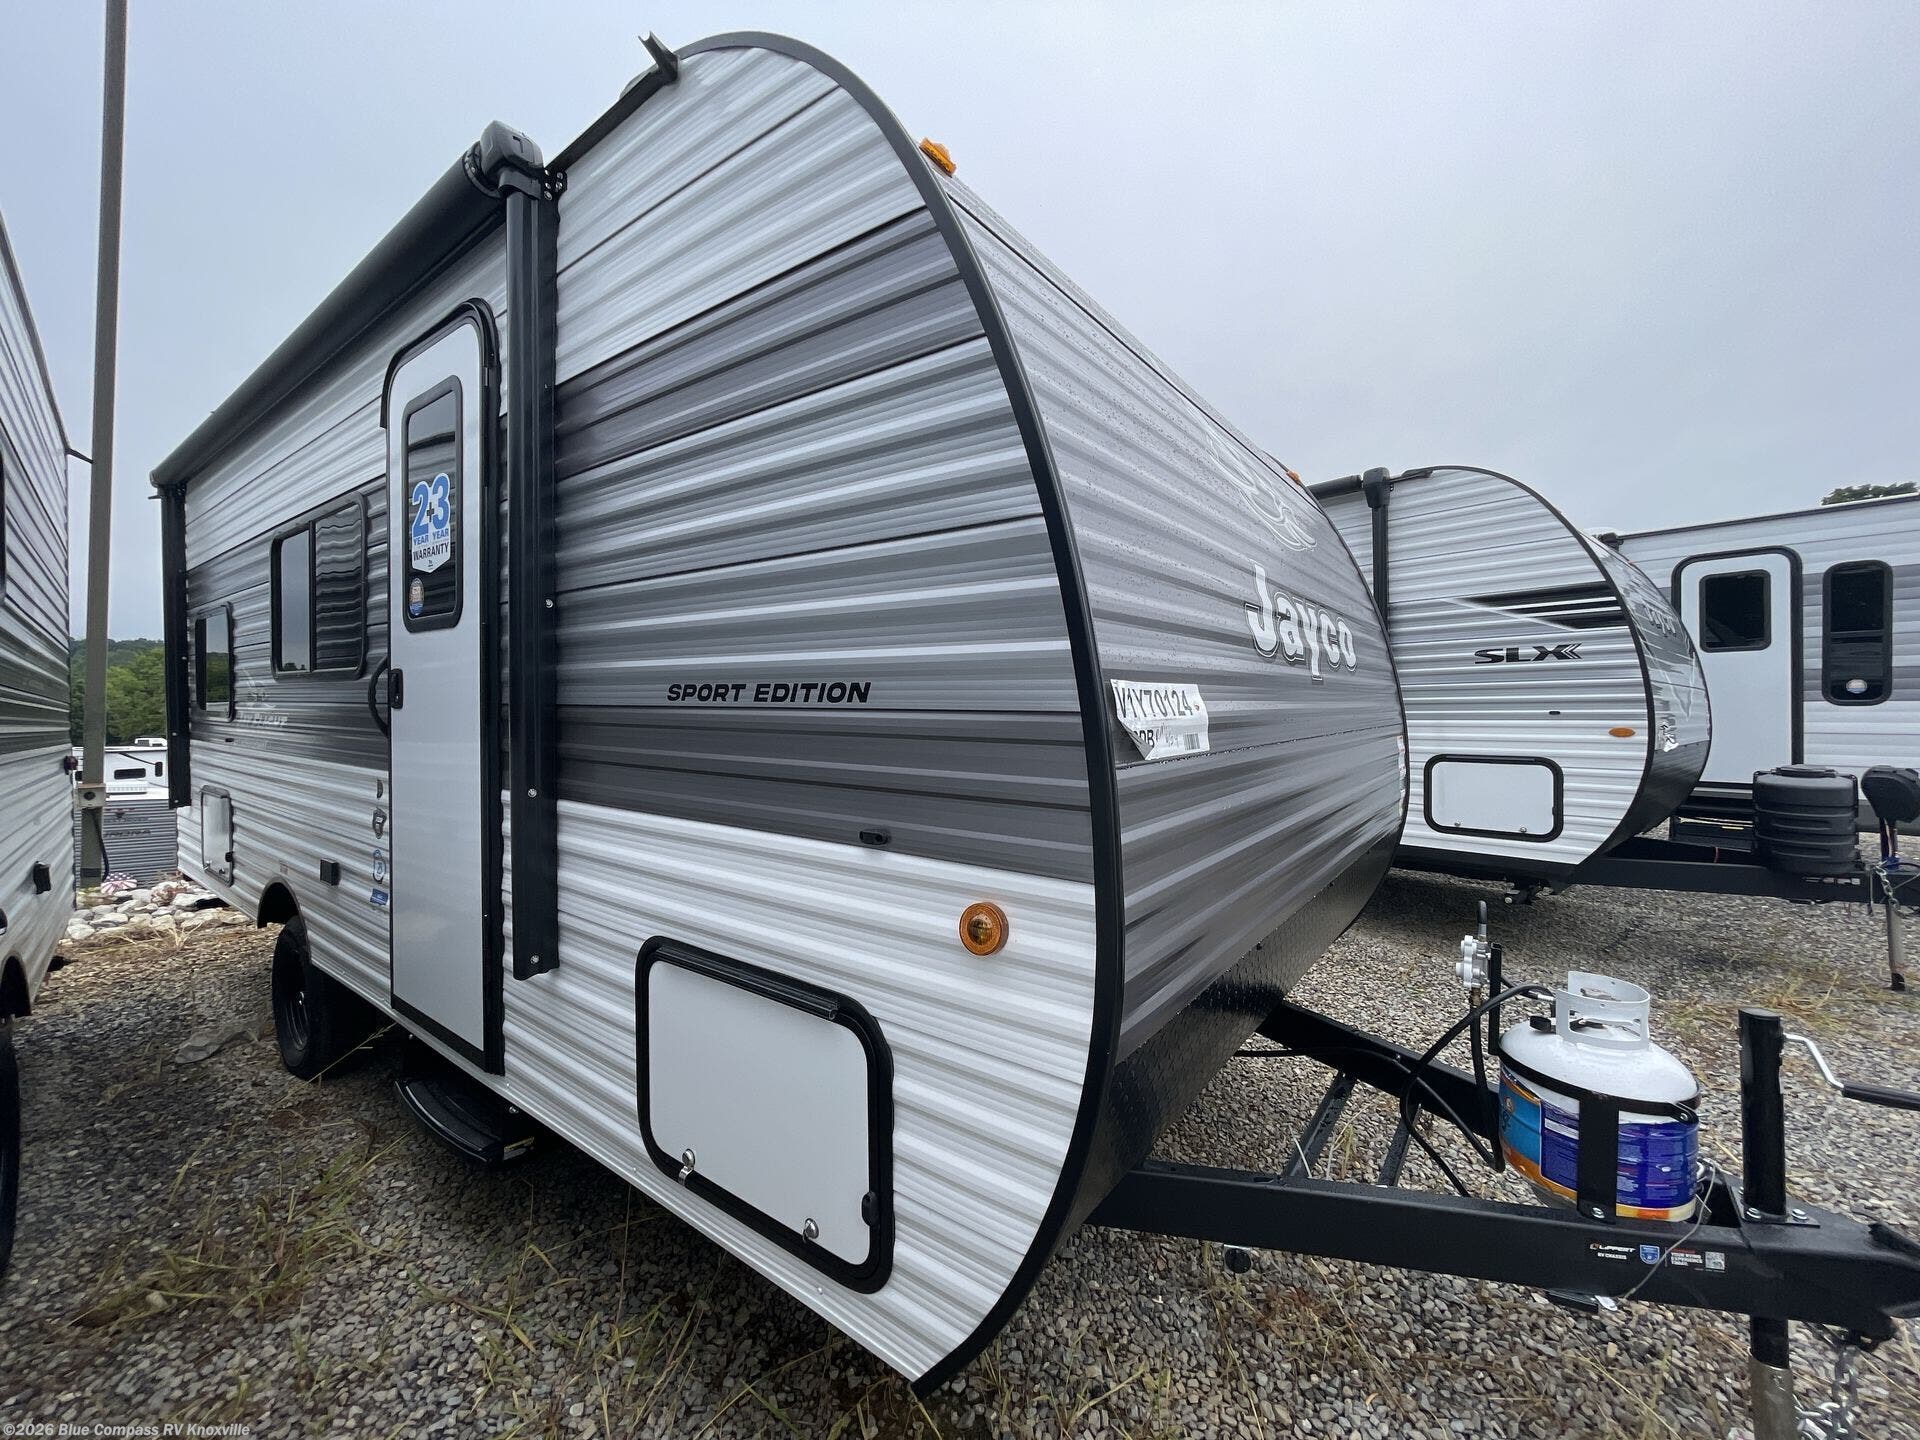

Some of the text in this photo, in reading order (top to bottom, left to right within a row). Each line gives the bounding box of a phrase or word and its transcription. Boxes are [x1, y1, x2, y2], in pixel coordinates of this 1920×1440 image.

[413, 528, 449, 546] YEAR YEAR
[413, 543, 449, 561] WARRANTY
[1245, 560, 1357, 681] Jayco
[1474, 643, 1582, 664] SLX
[667, 682, 872, 703] SPORT EDITION
[1115, 687, 1194, 719] V1Y70124
[1599, 1244, 1636, 1253] LIPPERT
